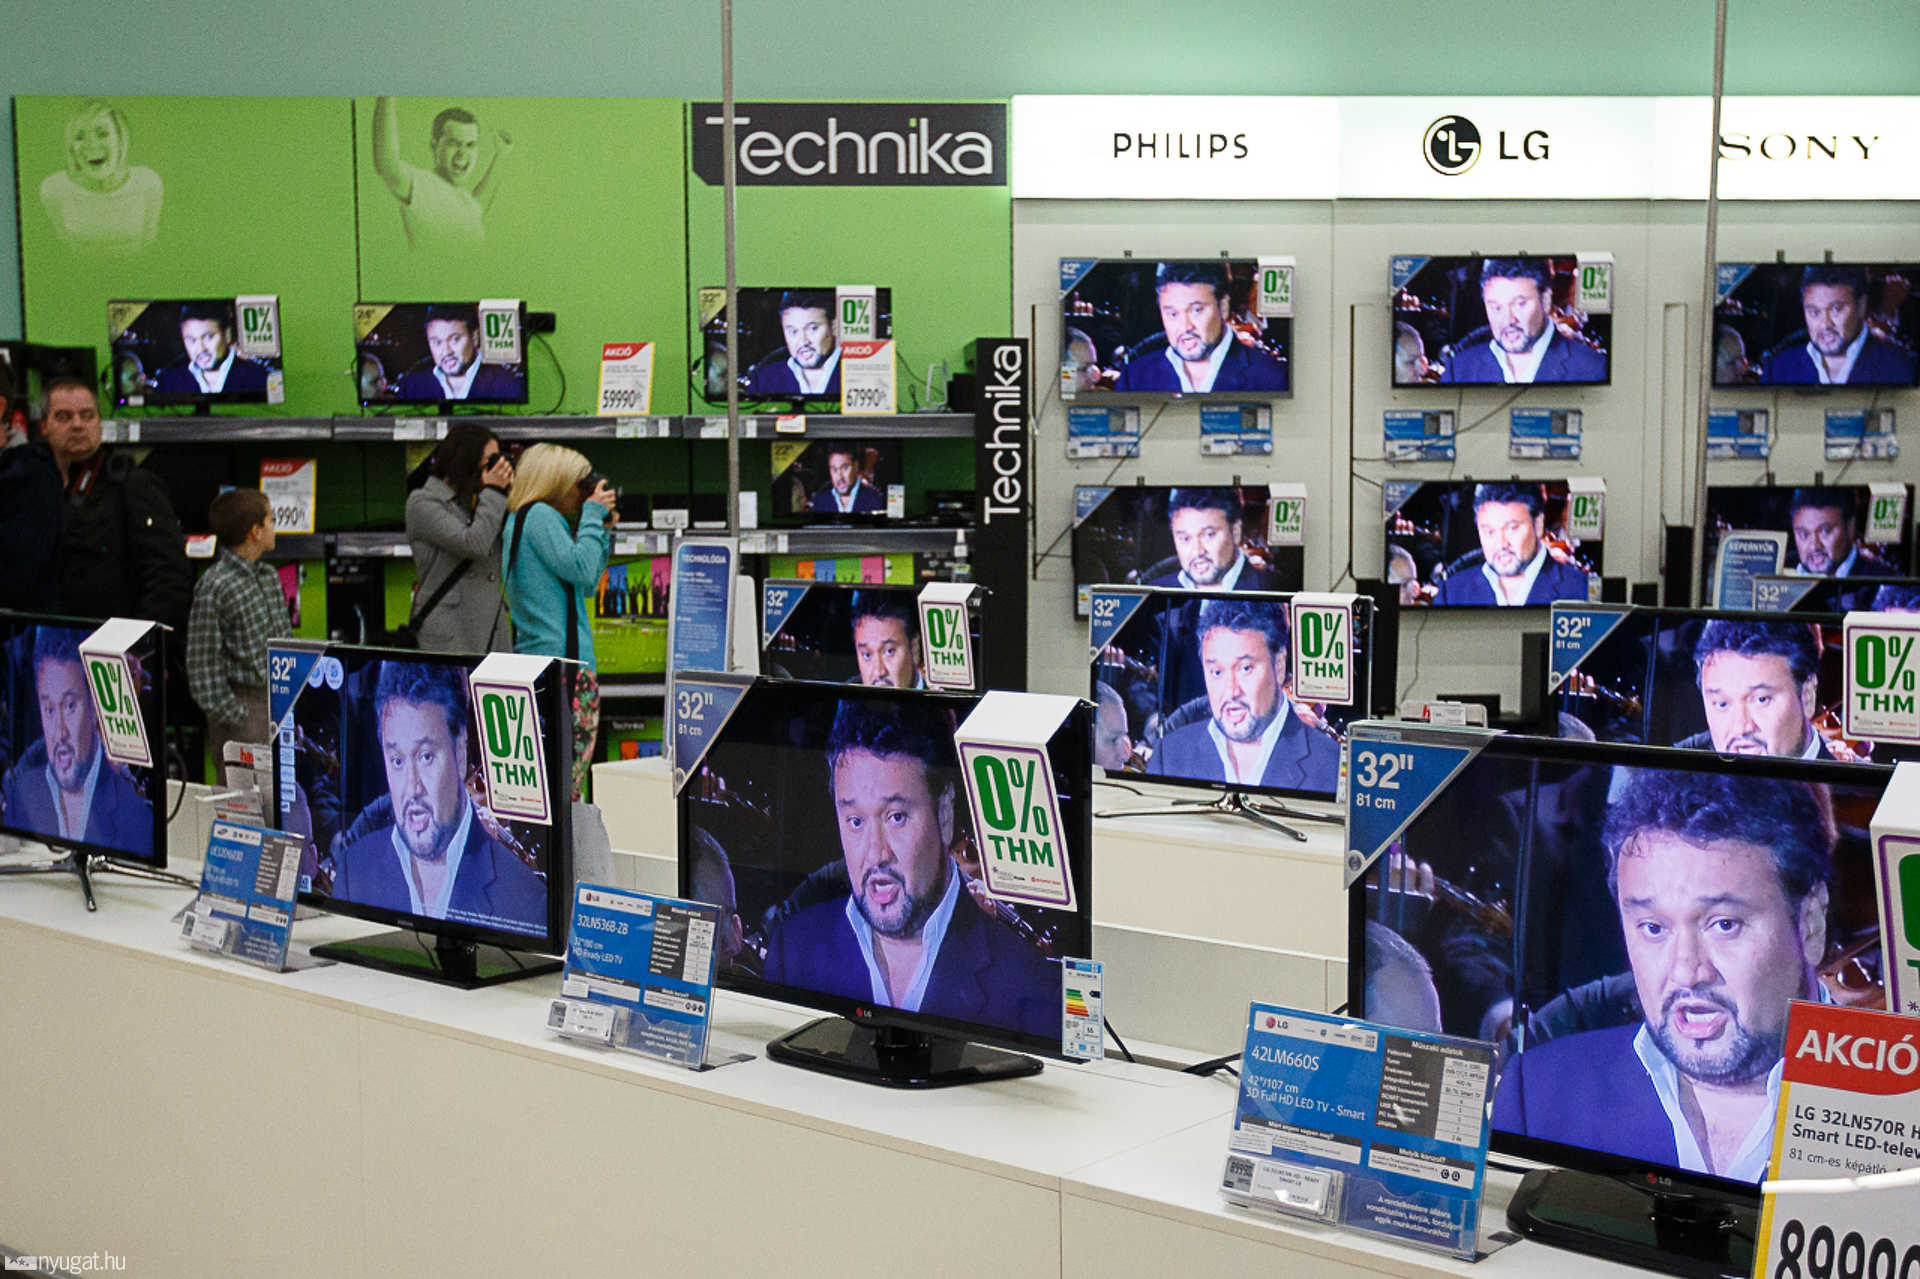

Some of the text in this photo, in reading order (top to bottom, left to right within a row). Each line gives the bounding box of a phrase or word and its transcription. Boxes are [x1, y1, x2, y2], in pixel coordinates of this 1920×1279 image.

[1113, 132, 1249, 159] PHILIPS
[1499, 130, 1549, 160] LG
[1717, 132, 1878, 161] SONY
[1264, 270, 1289, 294] 0%
[243, 307, 273, 332] 0%
[843, 300, 870, 324] 0%
[485, 313, 514, 338] 0%
[984, 345, 1022, 525] Technika
[1275, 501, 1300, 523] 0%
[767, 590, 789, 607] 32"
[1758, 586, 1788, 601] 32"
[1094, 599, 1120, 617] 32"
[927, 608, 964, 650] 0%
[1301, 612, 1344, 660] 0%
[1556, 616, 1591, 638] 32"
[272, 656, 297, 681] 32"
[931, 651, 965, 666] THM
[1302, 661, 1344, 679] THM
[1856, 635, 1915, 691] 0%
[91, 661, 134, 716] 0%
[678, 691, 713, 721] 32"
[1856, 693, 1914, 714] THM
[104, 715, 139, 737] THM
[482, 693, 534, 761] 0%
[491, 761, 538, 788] THM
[1357, 750, 1414, 789] 32"
[973, 755, 1049, 836] 0%
[1356, 792, 1396, 810] 81 cm
[988, 834, 1055, 868] THM
[1277, 1020, 1289, 1029] LG
[1251, 1045, 1320, 1071] 42LM660S
[1795, 1029, 1919, 1076] AKCIÓ
[1285, 1083, 1299, 1094] cm
[1246, 1087, 1259, 1098] 3D
[1261, 1090, 1277, 1101] Full
[1279, 1094, 1294, 1105] HD
[1295, 1097, 1314, 1109] LED
[1316, 1101, 1330, 1112] TV
[1336, 1104, 1365, 1120] Smart
[1795, 1104, 1816, 1121] LG
[1821, 1109, 1905, 1137] 32LN570R
[1792, 1123, 1840, 1145] Smart
[1789, 1147, 1803, 1160] 81
[1807, 1152, 1841, 1168] cm-es
